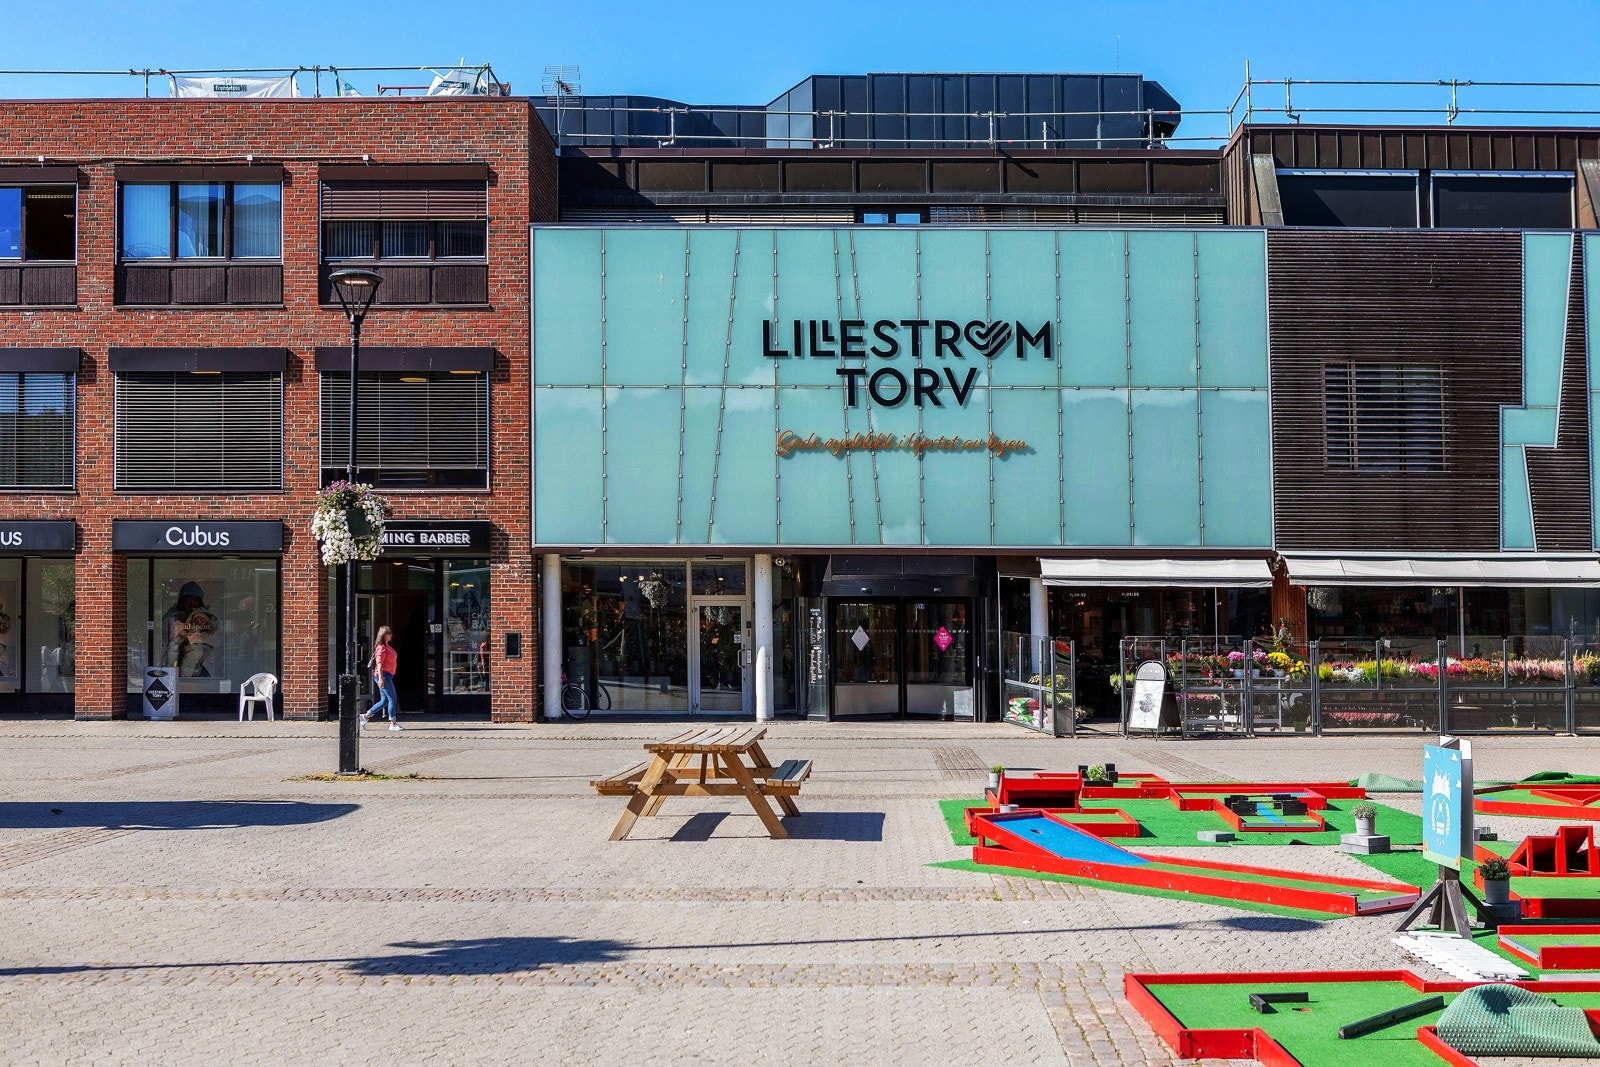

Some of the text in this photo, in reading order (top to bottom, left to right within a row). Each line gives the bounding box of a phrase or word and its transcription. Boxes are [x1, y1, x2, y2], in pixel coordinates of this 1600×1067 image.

[836, 367, 978, 407] TORV
[776, 430, 820, 457] Gode
[897, 434, 907, 449] i
[907, 432, 960, 457] hjertet
[961, 438, 983, 449] av
[986, 431, 1027, 457] byen
[165, 525, 230, 546] Cubus
[419, 532, 471, 544] BARBER
